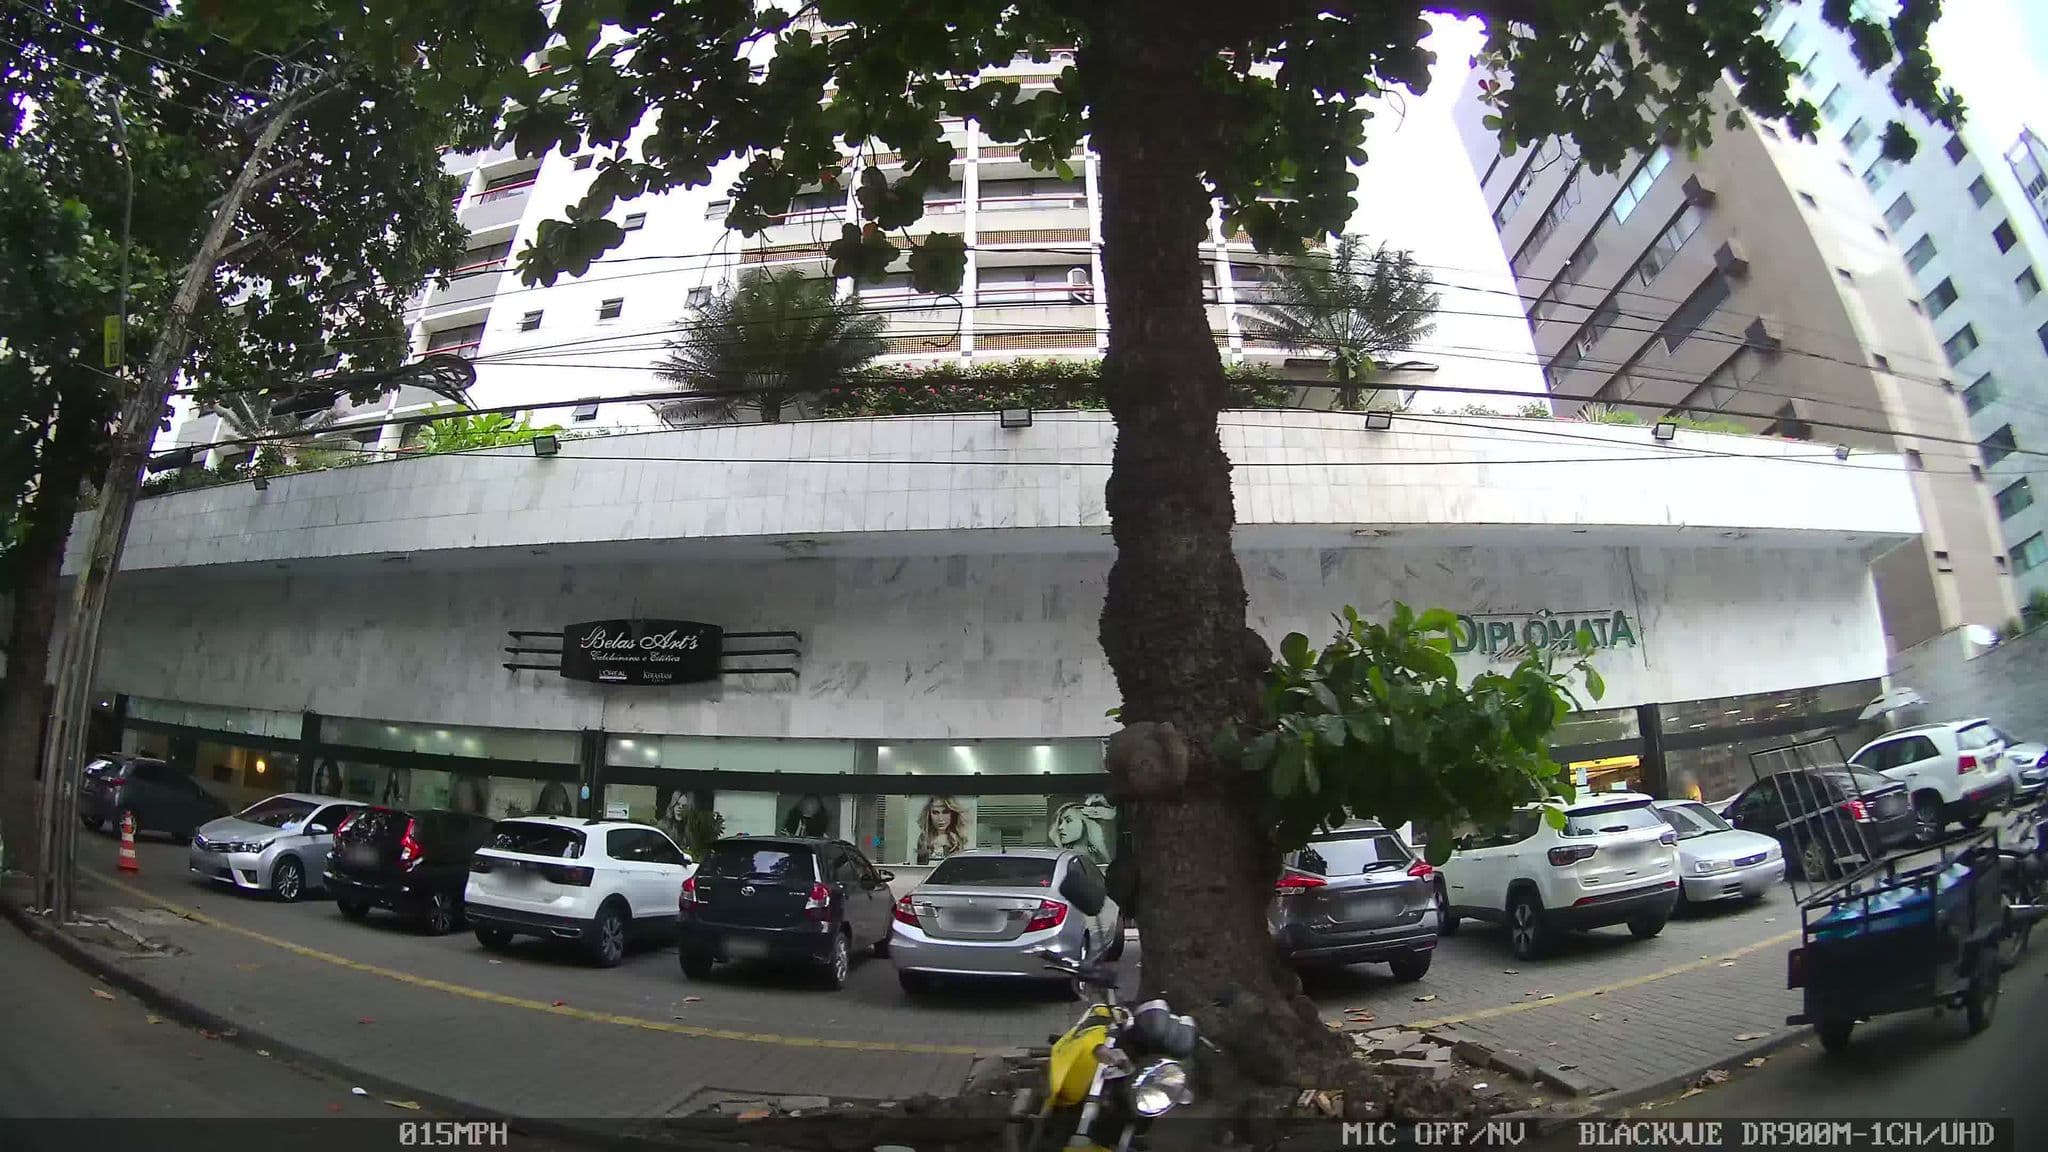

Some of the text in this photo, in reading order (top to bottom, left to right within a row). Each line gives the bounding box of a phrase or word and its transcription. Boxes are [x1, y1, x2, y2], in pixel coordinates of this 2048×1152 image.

[581, 626, 698, 649] Belas Art's
[1452, 610, 1636, 654] DIPLOMATA
